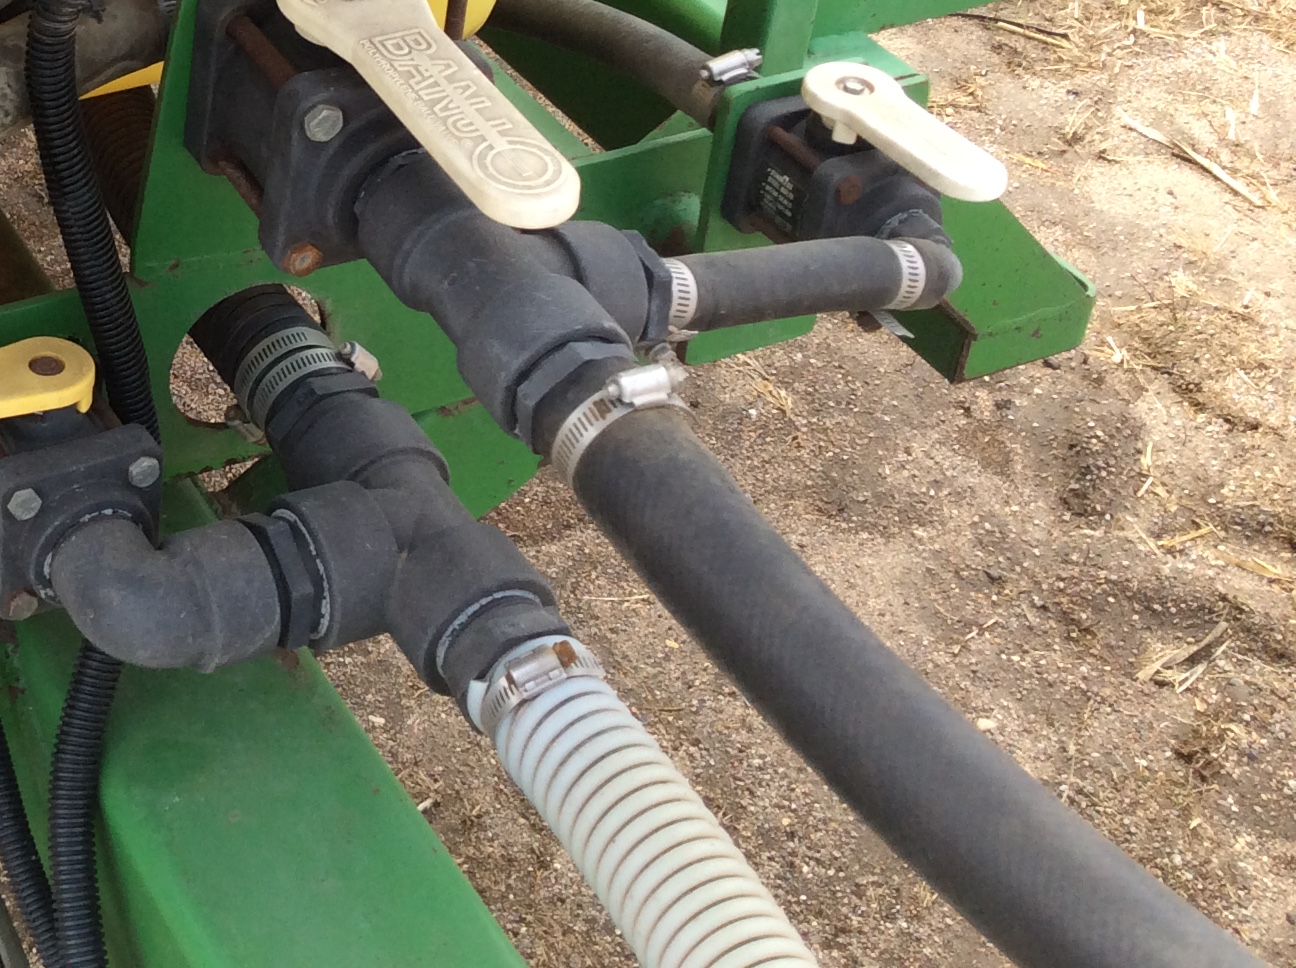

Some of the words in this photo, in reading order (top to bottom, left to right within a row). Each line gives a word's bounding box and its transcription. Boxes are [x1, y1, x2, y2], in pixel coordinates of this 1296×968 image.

[359, 39, 418, 102] POLYPROPYLENE
[413, 99, 436, 121] BALL
[374, 28, 561, 193] BANJO
